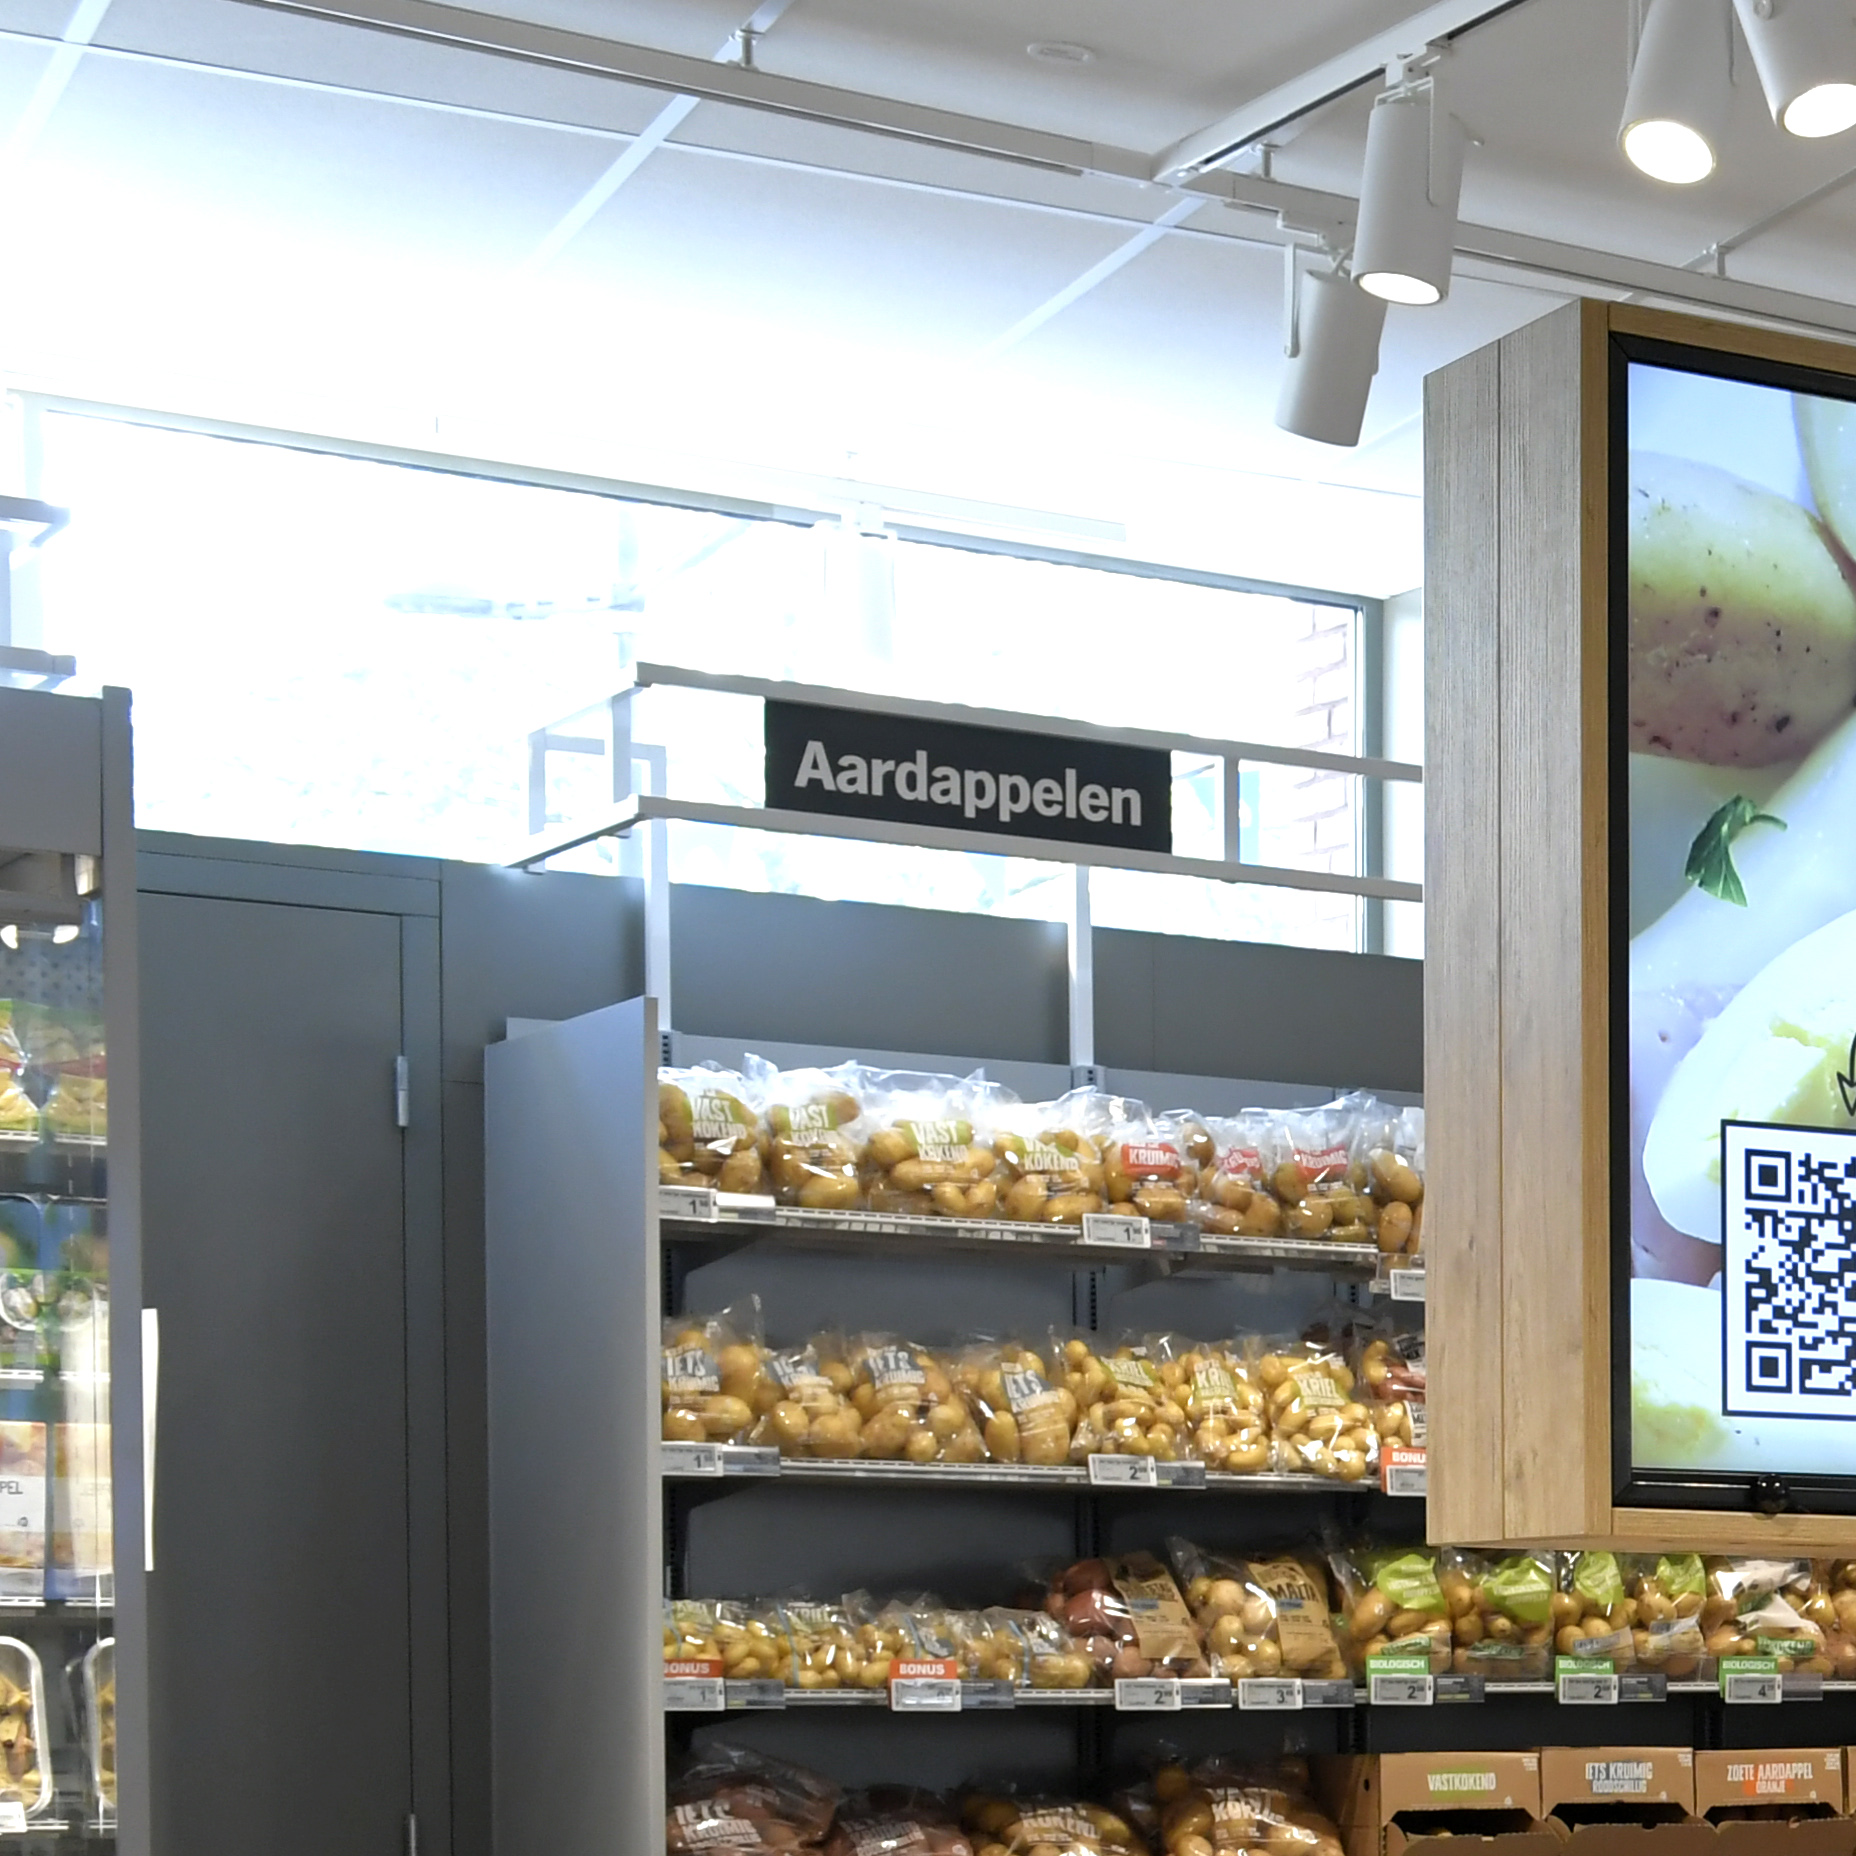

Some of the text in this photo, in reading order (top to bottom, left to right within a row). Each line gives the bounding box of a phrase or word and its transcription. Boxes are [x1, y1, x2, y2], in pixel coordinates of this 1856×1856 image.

[794, 740, 1142, 827] Aardappelen
[691, 1102, 734, 1122] VAST
[911, 1121, 958, 1142] VAST
[1302, 1153, 1347, 1168] KRUIMIG
[666, 1353, 706, 1376] IETS
[900, 1663, 945, 1675] BONUS
[1369, 1660, 1425, 1669] BIOLOGISCH
[1722, 1660, 1775, 1671] BIOLOGISCH
[1585, 1762, 1653, 1780] IETS KRUIMIG
[1727, 1763, 1813, 1781] ZOETE AARDAPPEL
[1428, 1773, 1496, 1791] VASTKOKEND
[1592, 1780, 1647, 1793] ROODSCHILLIG
[1756, 1780, 1786, 1794] ORANJE
